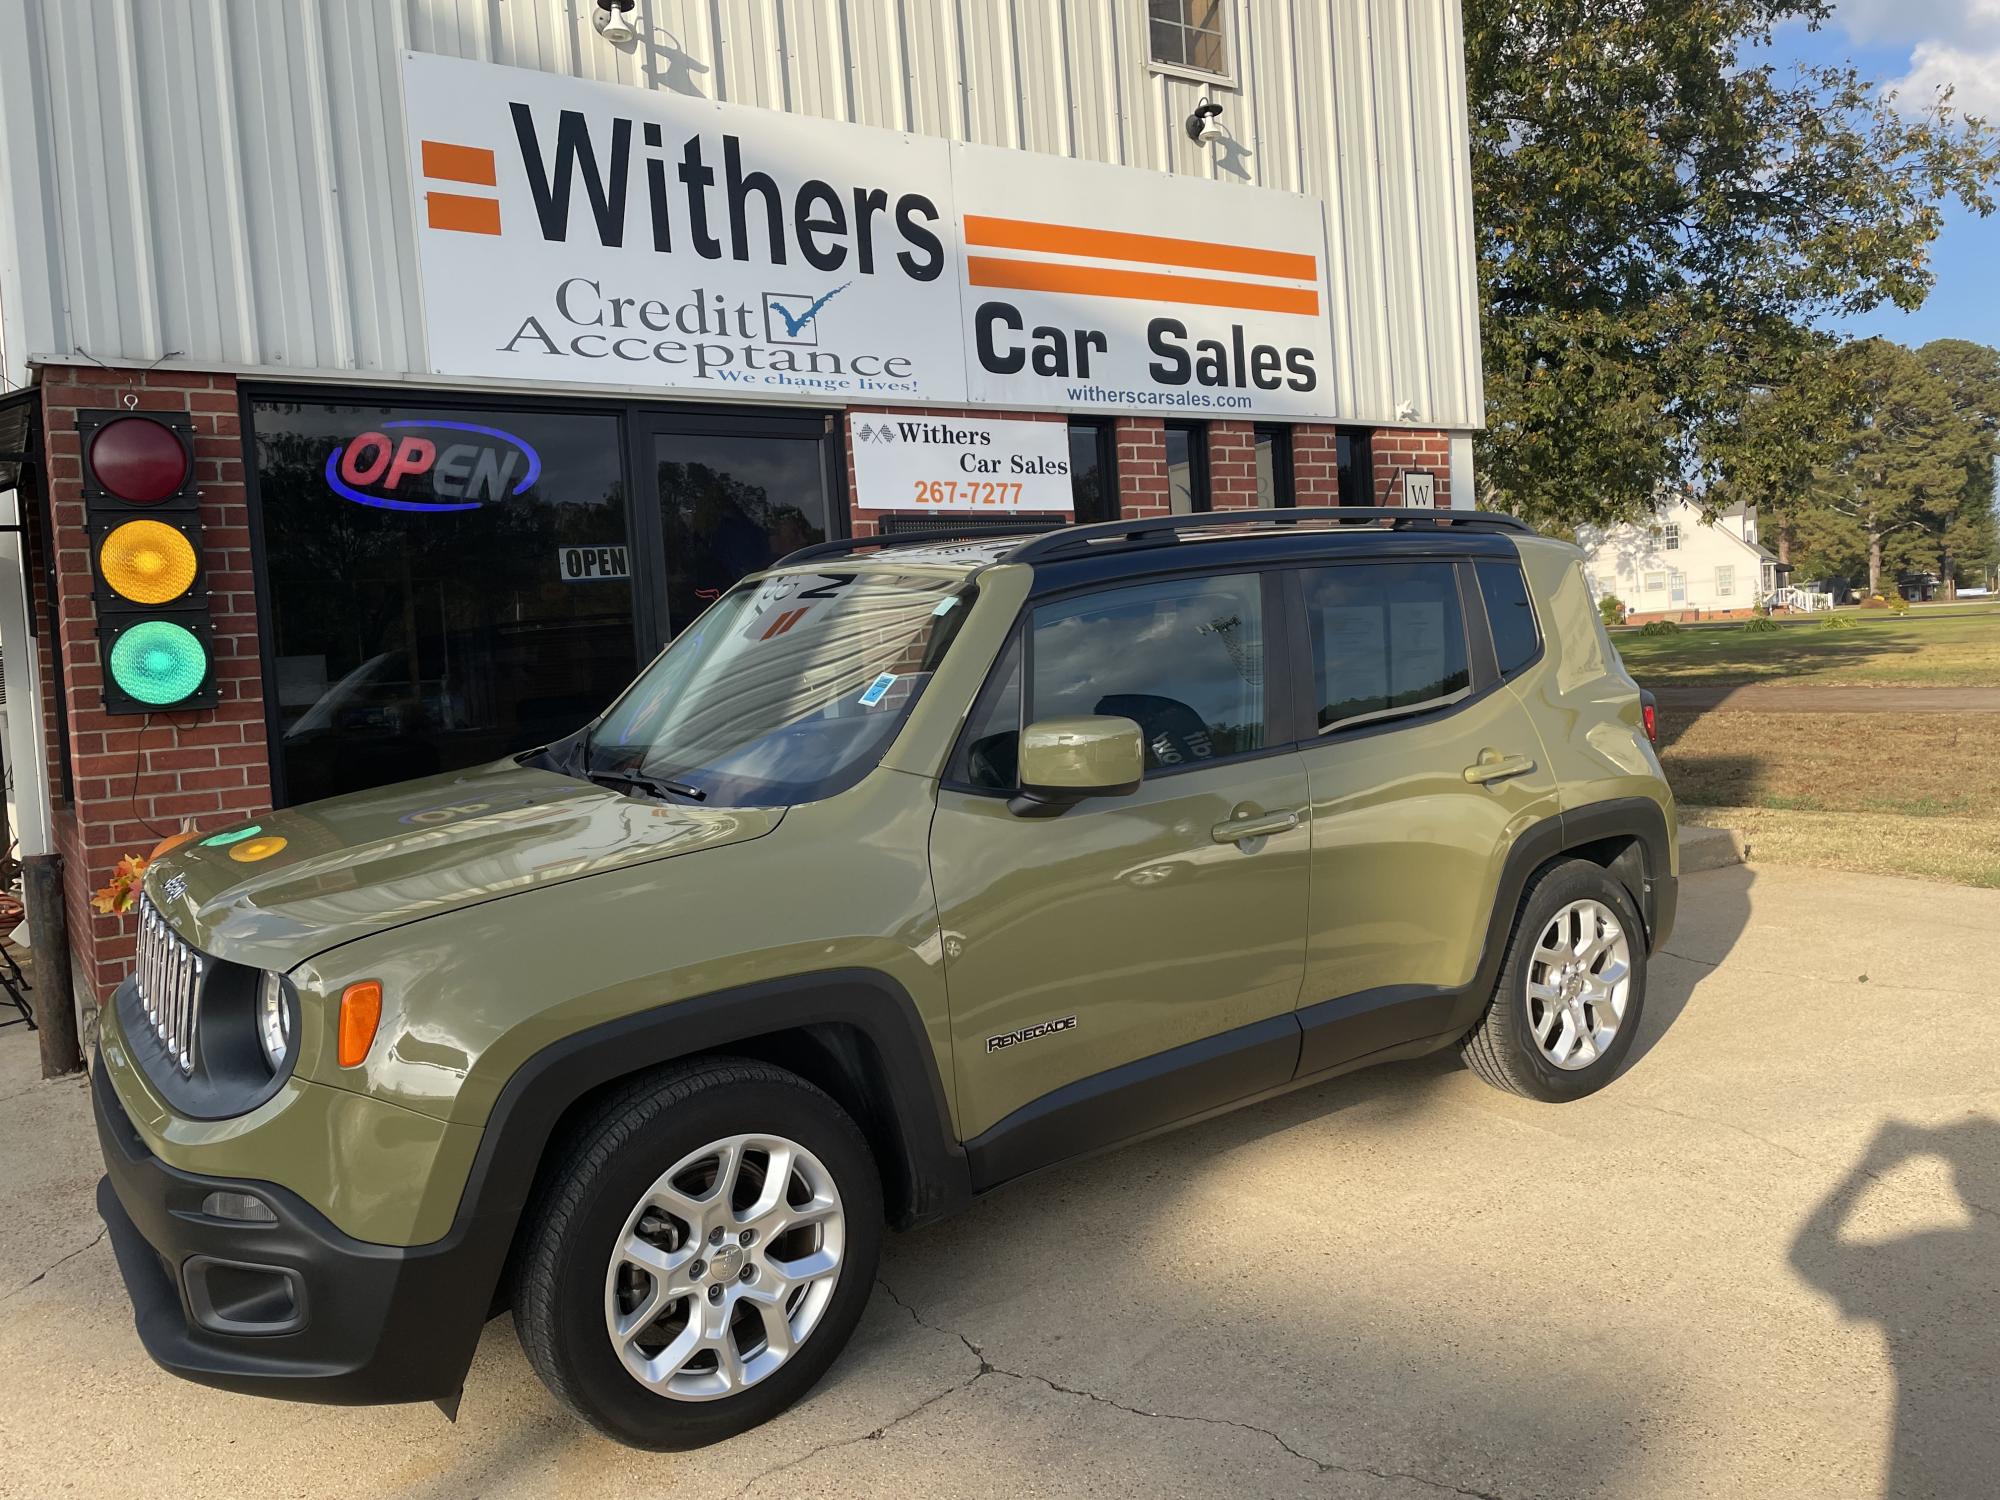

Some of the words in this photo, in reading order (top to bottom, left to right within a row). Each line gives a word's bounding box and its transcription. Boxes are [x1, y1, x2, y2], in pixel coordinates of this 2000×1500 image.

[509, 102, 944, 282] Withers
[555, 278, 757, 339] Credit
[496, 316, 913, 378] Acceptance
[975, 301, 1107, 378] Car
[1147, 317, 1317, 392] Sales
[717, 369, 756, 384] We
[764, 373, 850, 392] change
[859, 378, 918, 392] lives!
[1067, 385, 1252, 409] witherscarsales.com
[897, 422, 991, 446] Withers
[341, 431, 519, 501] OPEN
[960, 453, 1001, 473] Car
[1010, 454, 1068, 475] Sales
[914, 480, 1023, 504] 267-7277
[1411, 485, 1429, 506] W
[565, 548, 627, 578] OPEN
[986, 1016, 1077, 1053] RENEGADE
